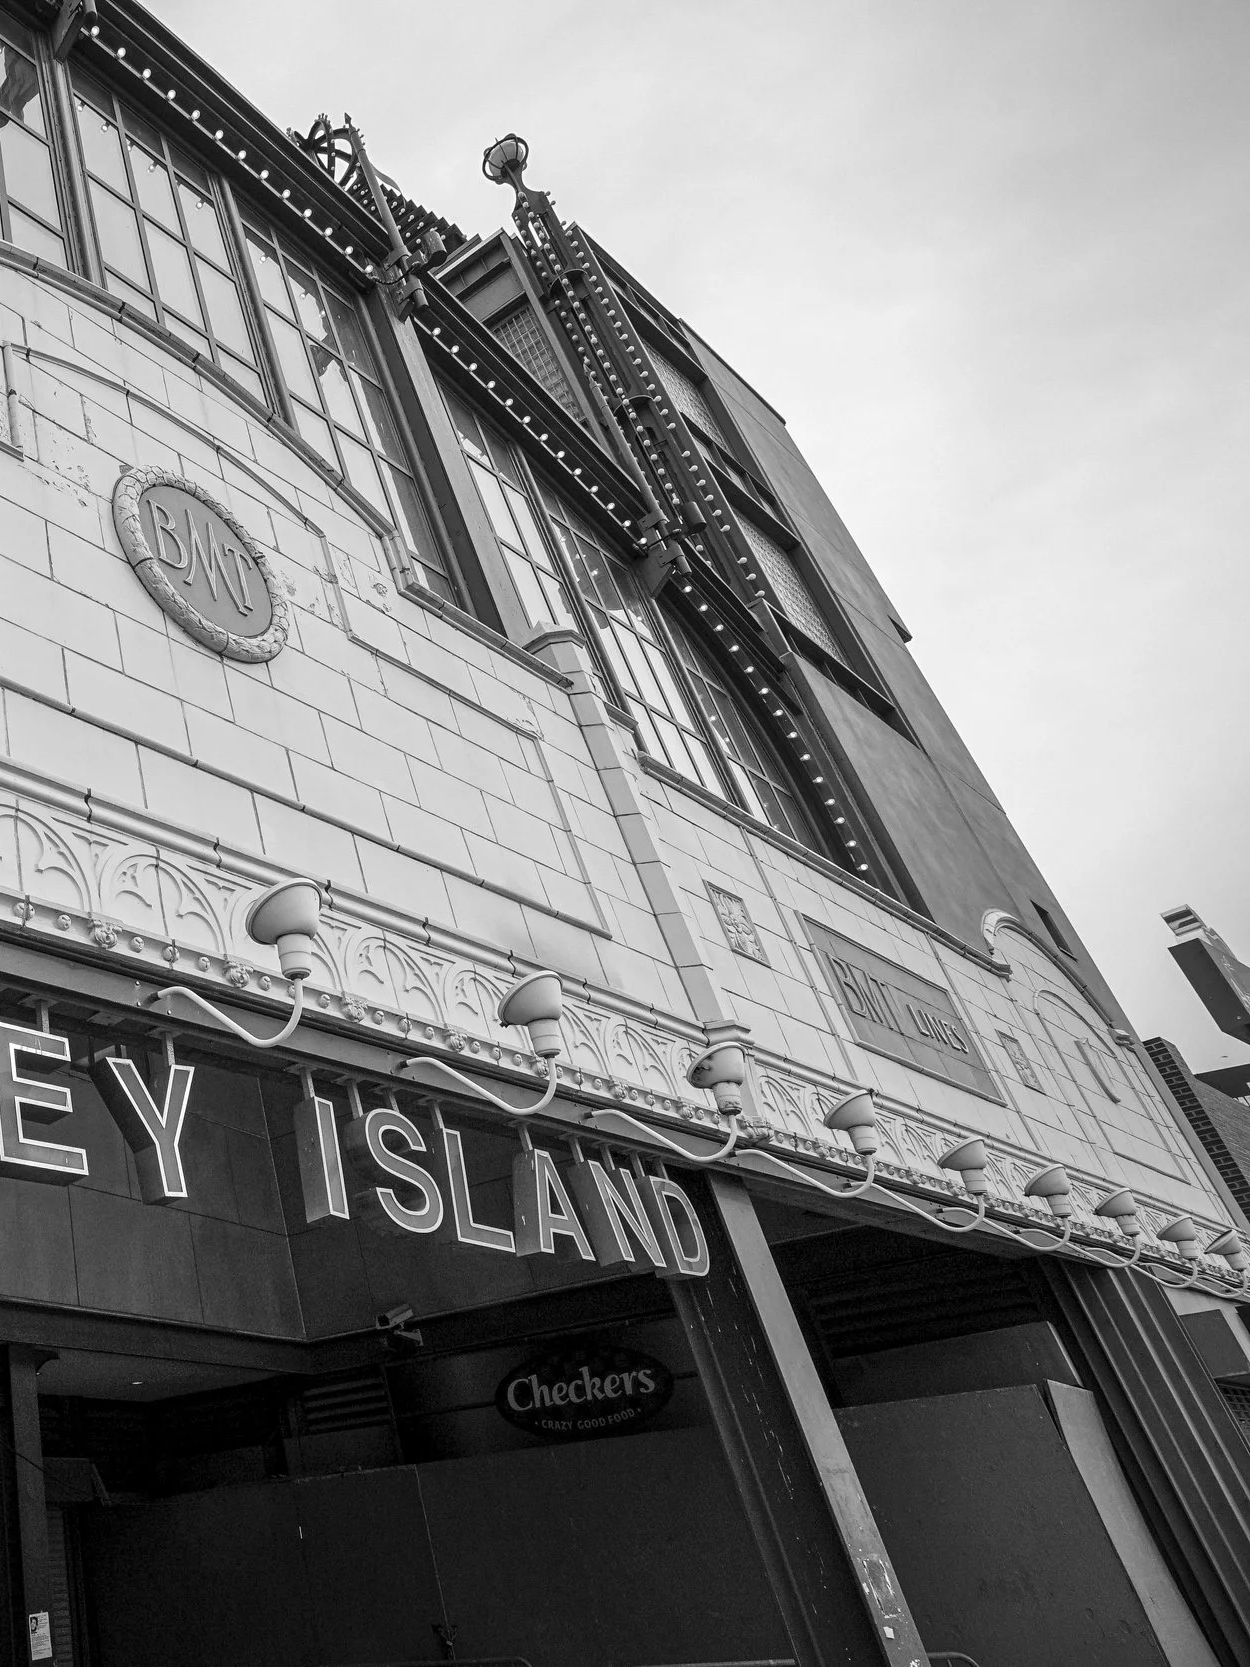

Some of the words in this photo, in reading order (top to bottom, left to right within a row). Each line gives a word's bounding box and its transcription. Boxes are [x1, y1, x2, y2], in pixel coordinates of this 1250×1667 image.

[146, 499, 253, 617] BMT
[826, 952, 905, 1035] BMT
[905, 1003, 969, 1054] LINES
[296, 1096, 710, 1279] ISLAND
[506, 1366, 656, 1411] Checkers
[541, 1419, 574, 1431] CRAZY
[577, 1417, 607, 1430] GOOD
[607, 1407, 636, 1425] FOOD
